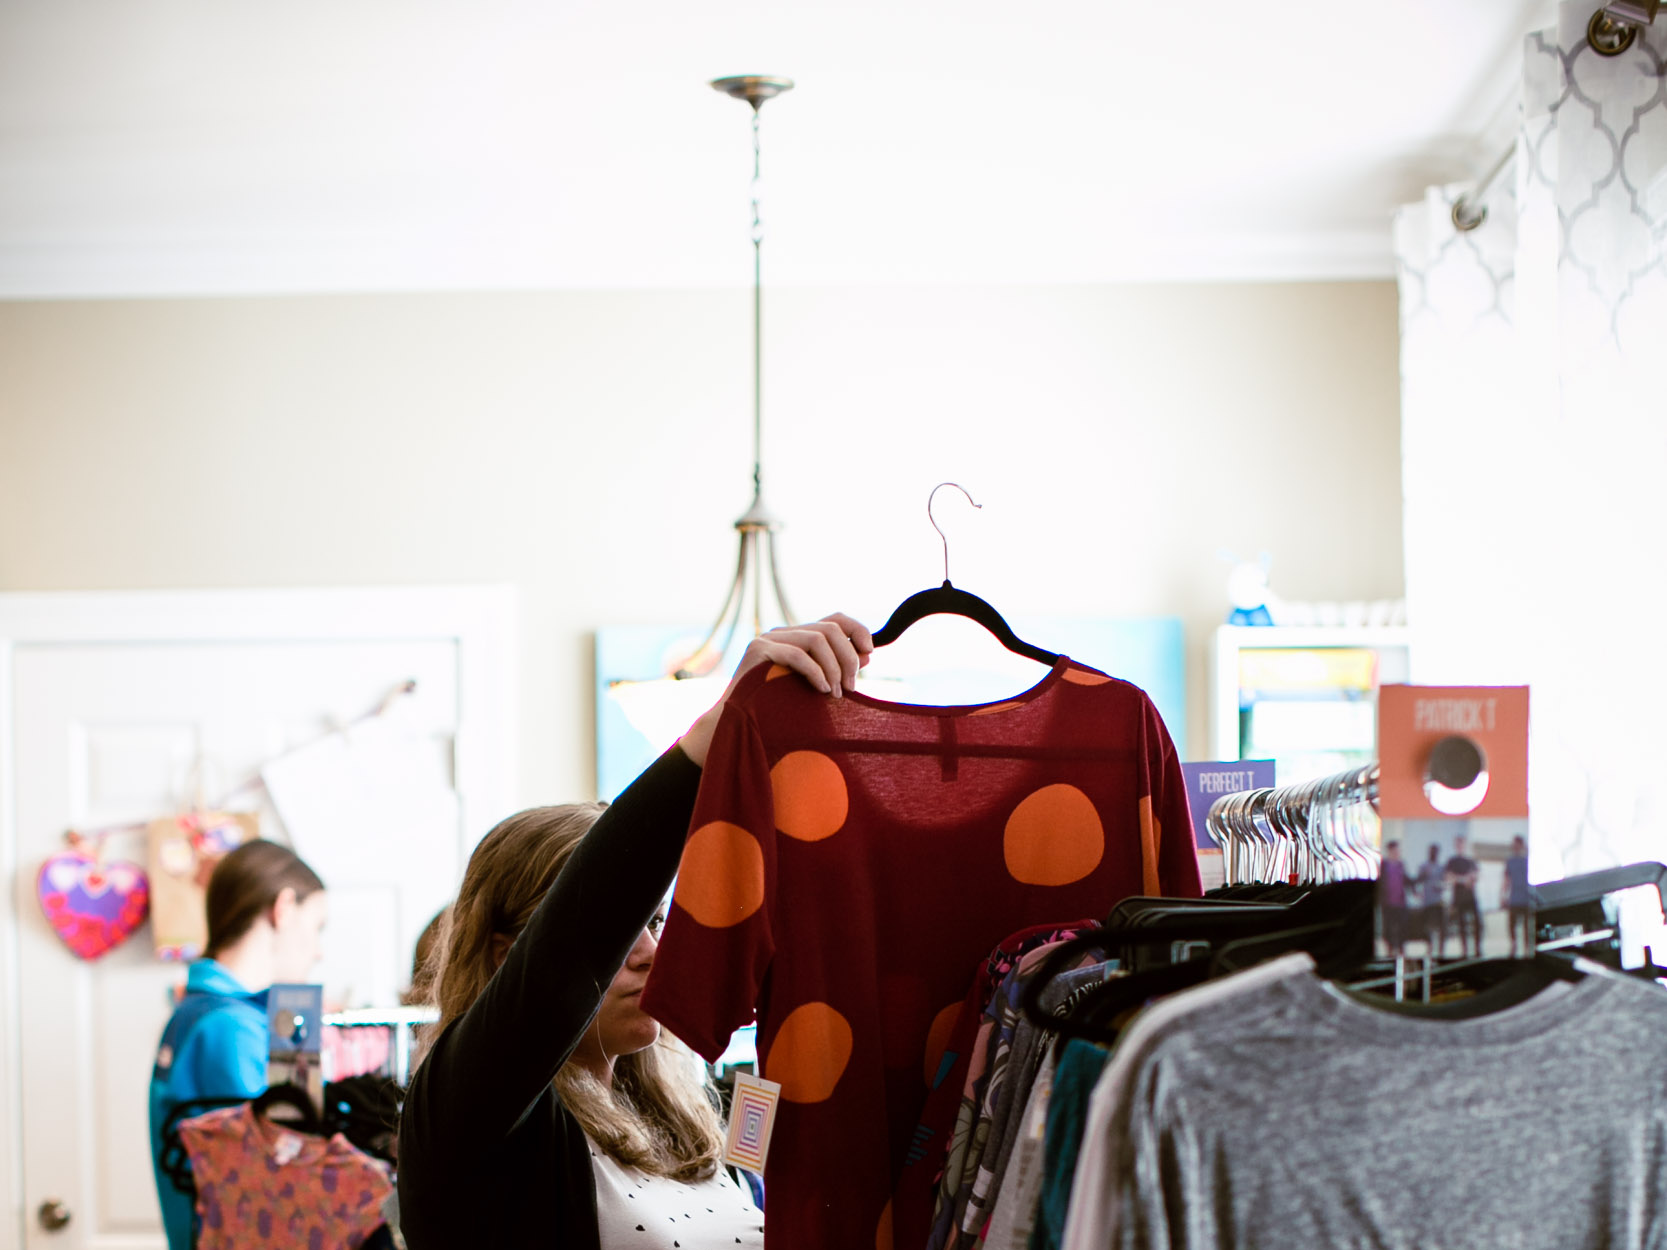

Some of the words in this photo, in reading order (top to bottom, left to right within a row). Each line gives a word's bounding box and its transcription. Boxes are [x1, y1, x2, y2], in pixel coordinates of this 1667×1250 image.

[1414, 698, 1484, 731] PATRICK
[1486, 697, 1498, 731] T
[1199, 771, 1245, 793] PERFECT
[1247, 771, 1255, 790] T
